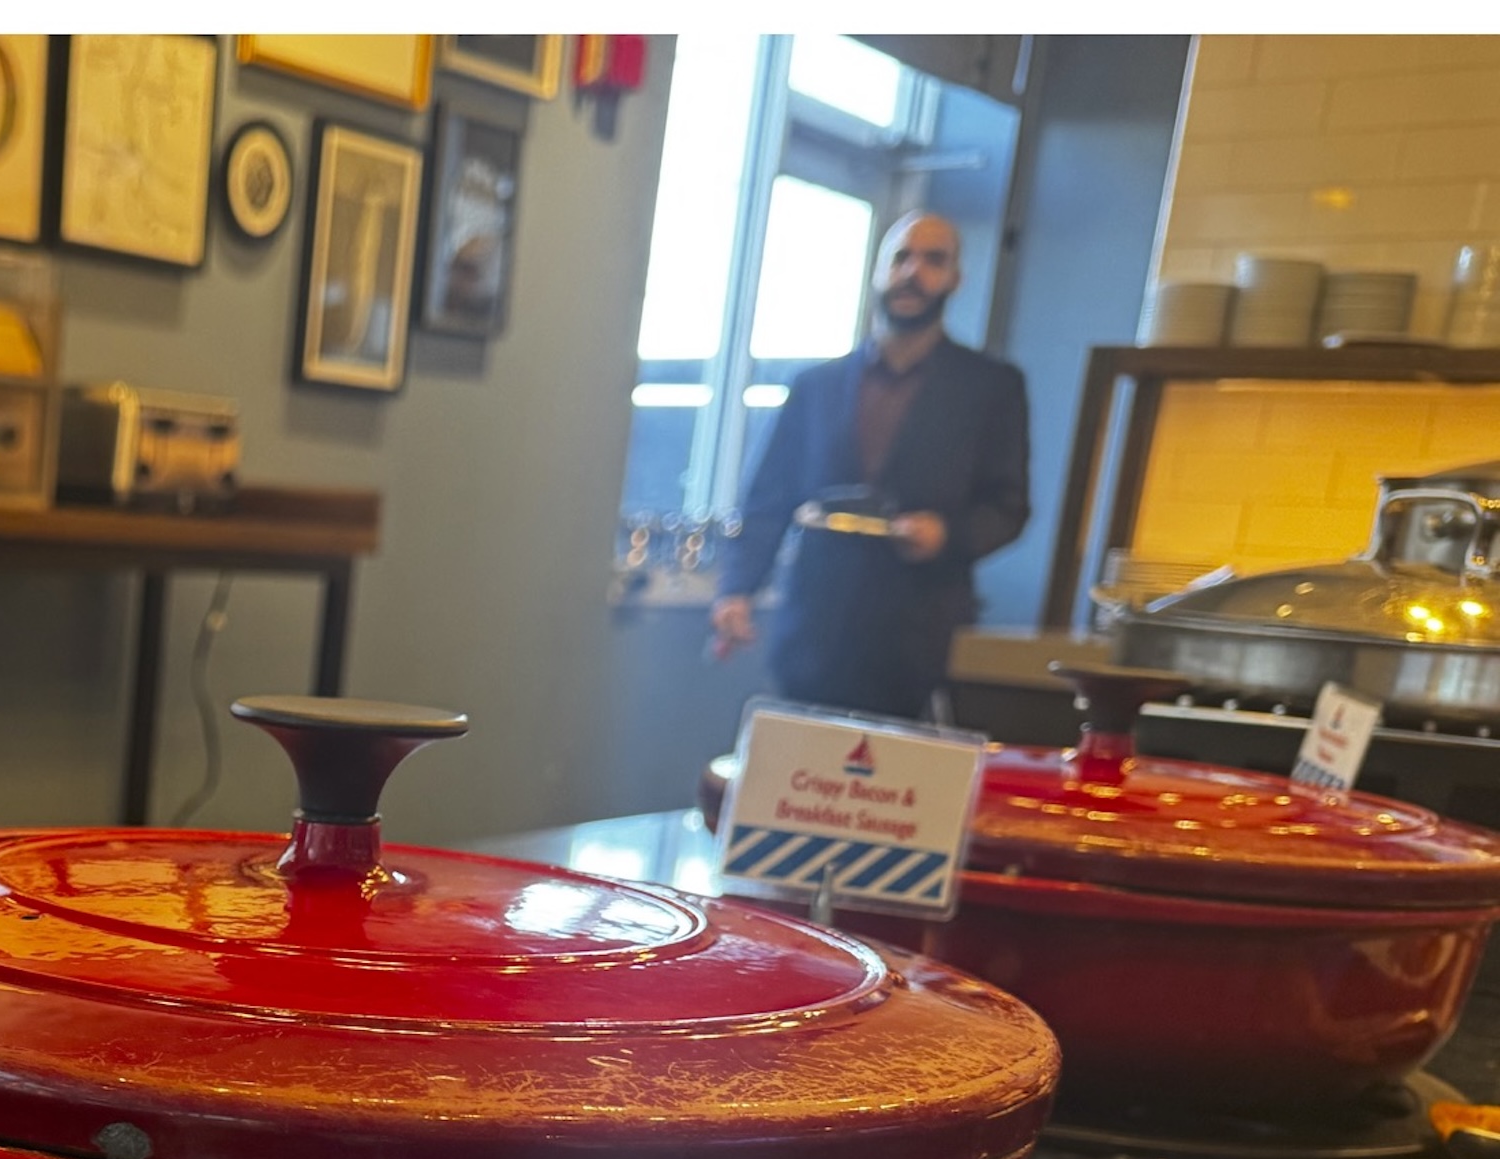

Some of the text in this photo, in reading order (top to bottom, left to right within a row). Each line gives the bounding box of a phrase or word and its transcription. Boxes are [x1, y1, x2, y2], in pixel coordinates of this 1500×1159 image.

[789, 768, 917, 807] Crispy Bacon &
[775, 798, 918, 841] Breakfast Sausage
